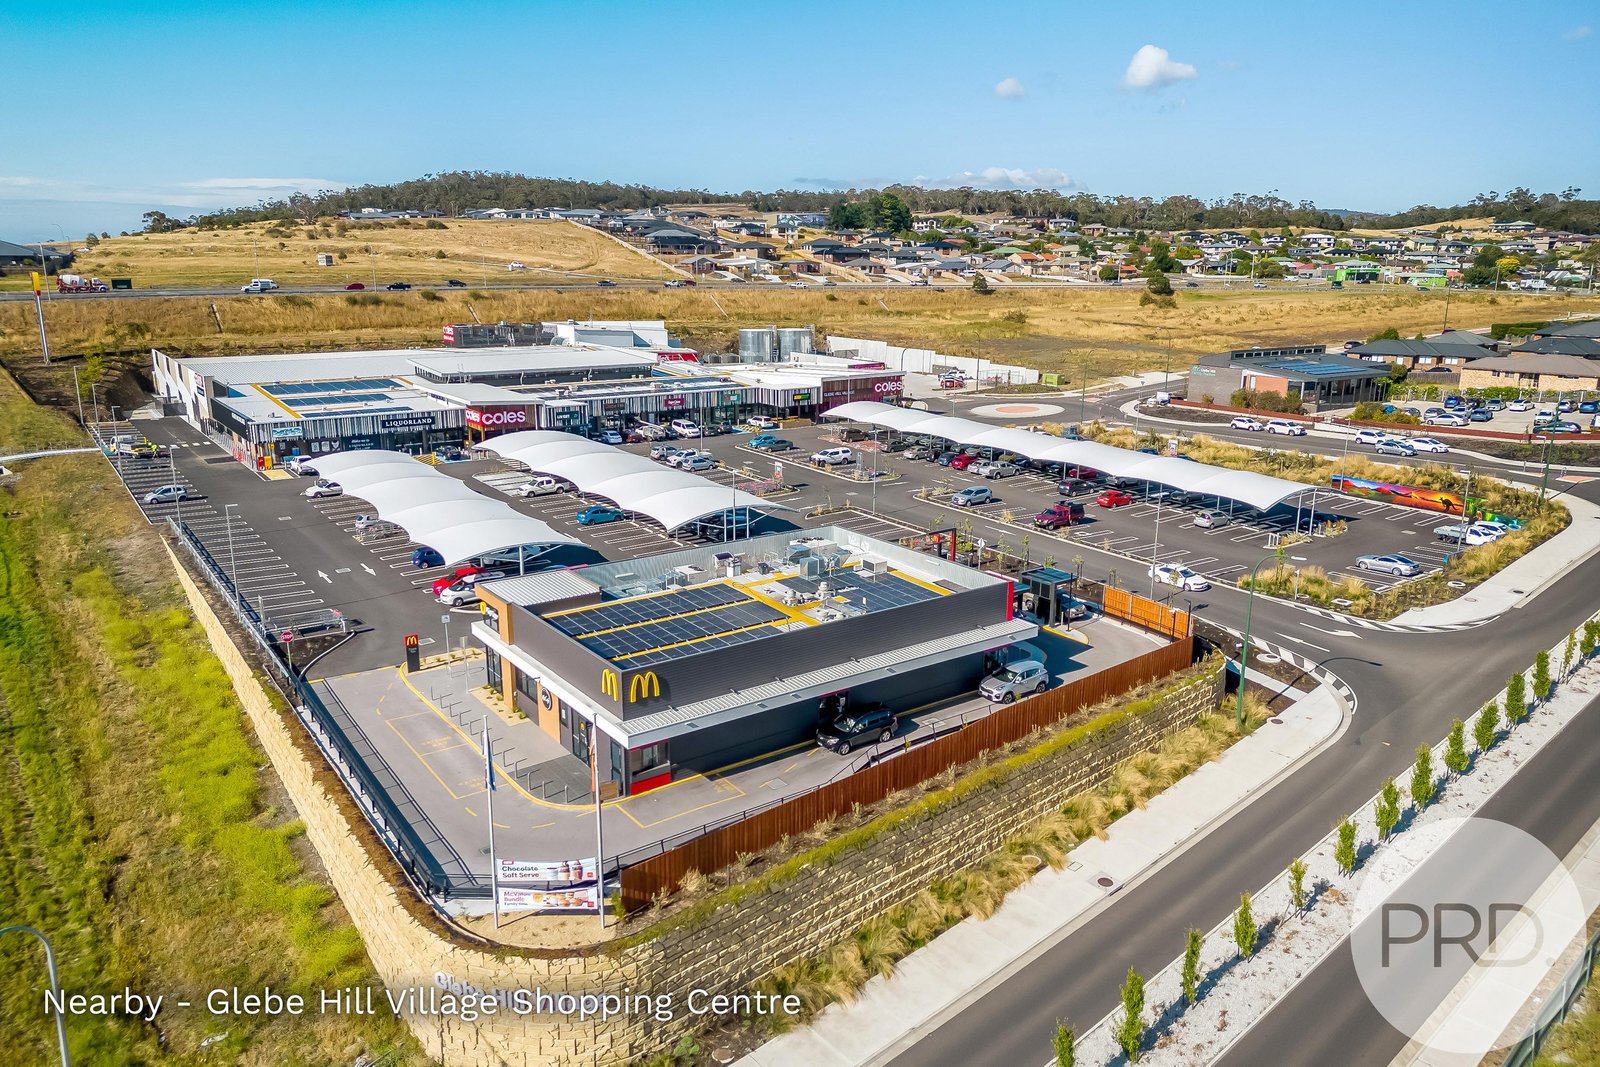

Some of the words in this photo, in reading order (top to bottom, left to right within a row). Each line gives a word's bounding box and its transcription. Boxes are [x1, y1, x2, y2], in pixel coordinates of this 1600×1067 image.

[875, 382, 902, 392] coles
[385, 418, 432, 426] LIQUORLAND
[481, 410, 526, 425] coles
